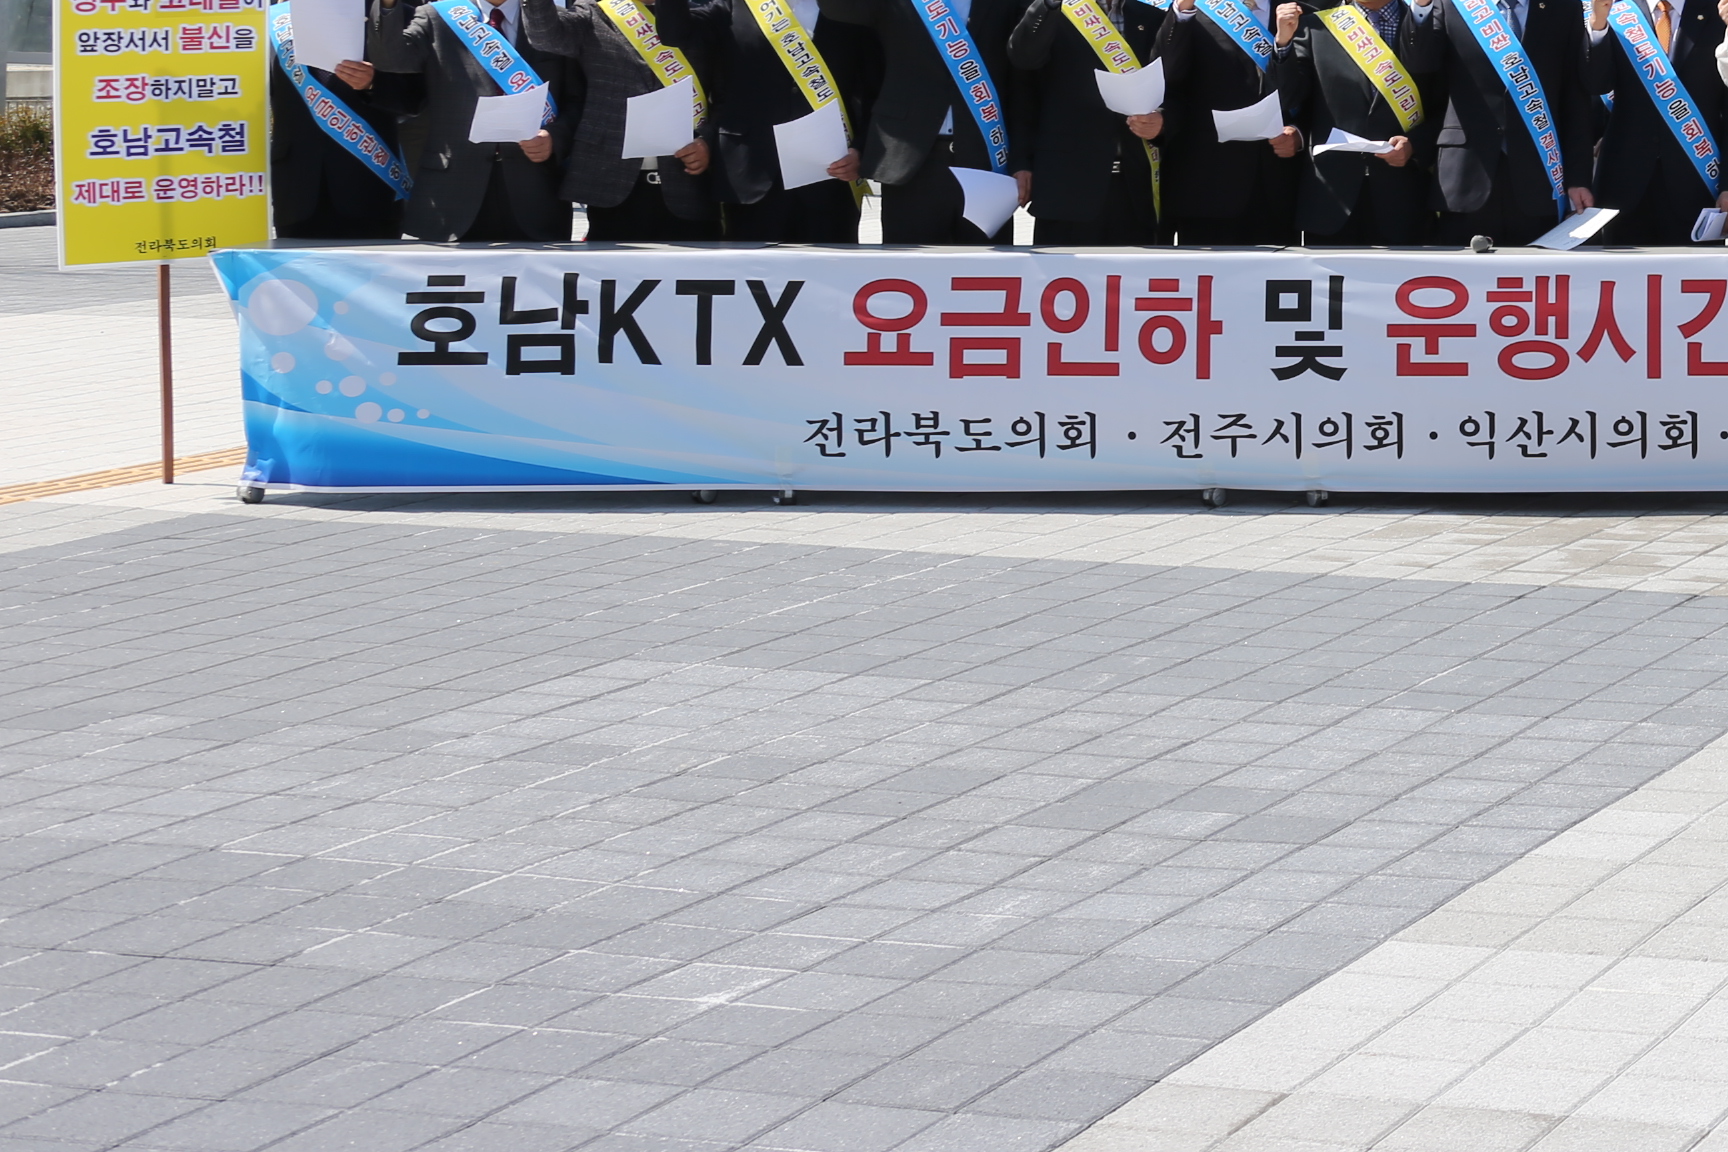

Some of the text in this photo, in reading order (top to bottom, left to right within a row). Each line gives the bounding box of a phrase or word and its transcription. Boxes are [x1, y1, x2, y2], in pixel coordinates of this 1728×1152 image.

[76, 23, 256, 54] 앞장서서 불신을
[95, 74, 240, 102] 조장하지말고
[88, 121, 248, 159] 호남고속철
[73, 173, 265, 205] 제대로 운영하라!!
[134, 236, 218, 254] 전라북도의회
[396, 271, 806, 377] 호남KTX
[843, 274, 1223, 380] 요금인하
[1264, 274, 1348, 382] 및
[803, 409, 1099, 460] 전라북도의회
[1160, 410, 1405, 460] 전주시의회
[1458, 409, 1700, 460] 익산시의회
